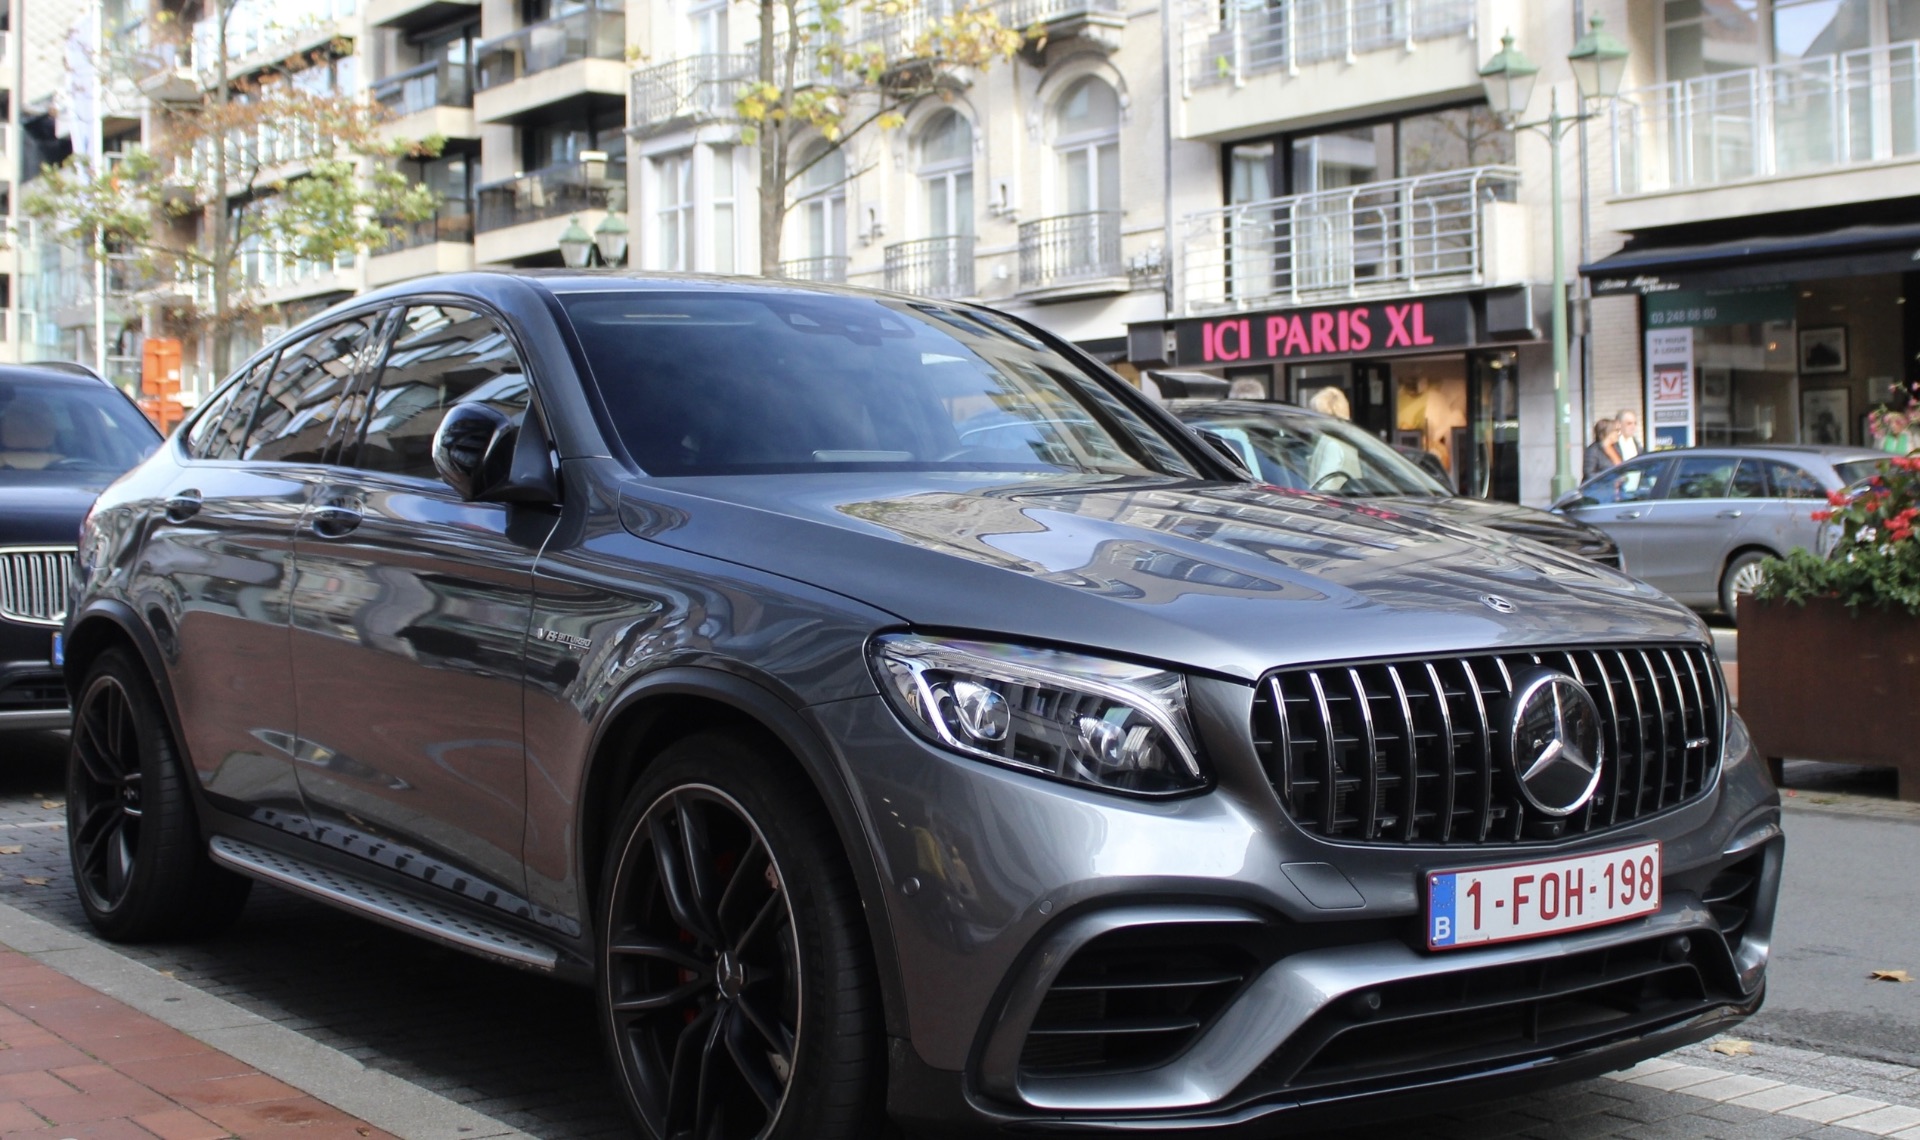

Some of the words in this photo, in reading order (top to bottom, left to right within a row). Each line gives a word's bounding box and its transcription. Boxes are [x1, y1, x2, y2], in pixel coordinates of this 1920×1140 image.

[1203, 319, 1250, 362] ICI
[1266, 308, 1371, 357] PARIS
[1385, 302, 1434, 348] XL
[537, 627, 556, 642] V8
[1467, 855, 1654, 930] 1-FOH-198
[1435, 916, 1451, 939] B
